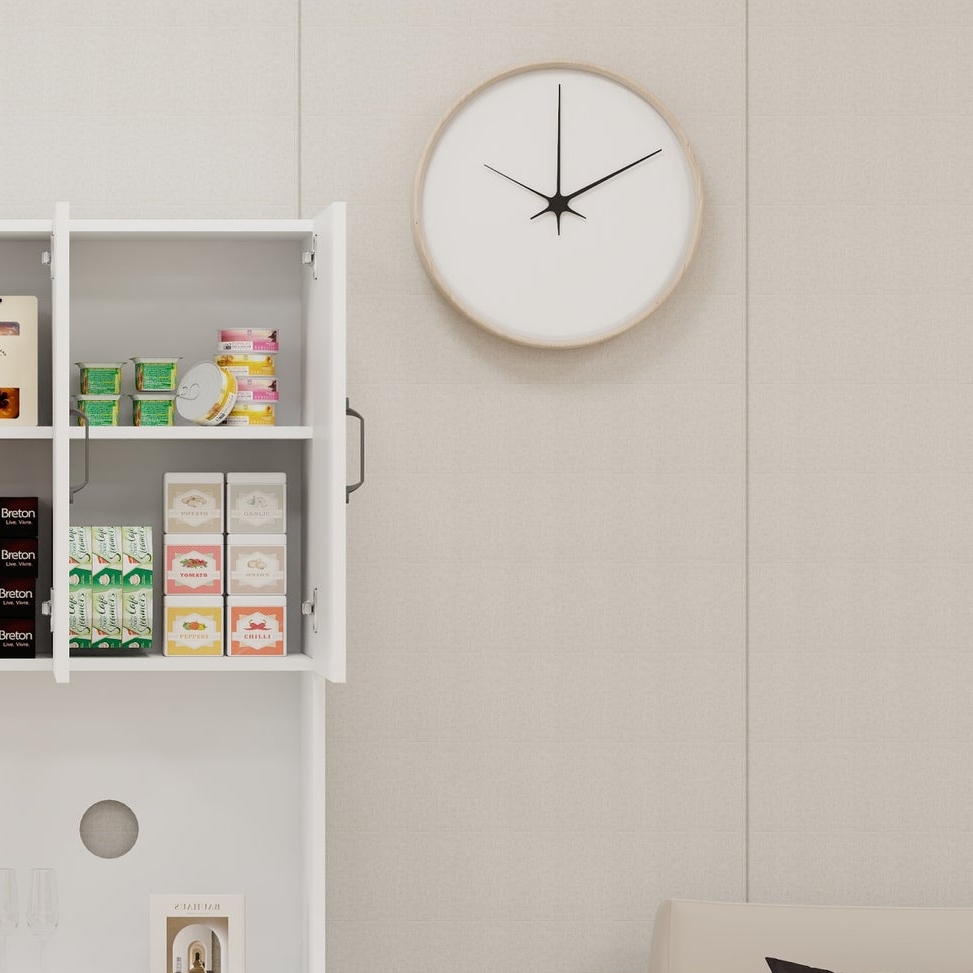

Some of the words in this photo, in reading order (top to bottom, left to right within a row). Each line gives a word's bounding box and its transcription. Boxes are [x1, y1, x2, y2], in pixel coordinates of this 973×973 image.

[1, 508, 35, 518] Breton
[1, 550, 35, 560] Breton
[0, 588, 32, 598] Breton
[0, 630, 32, 640] Breton
